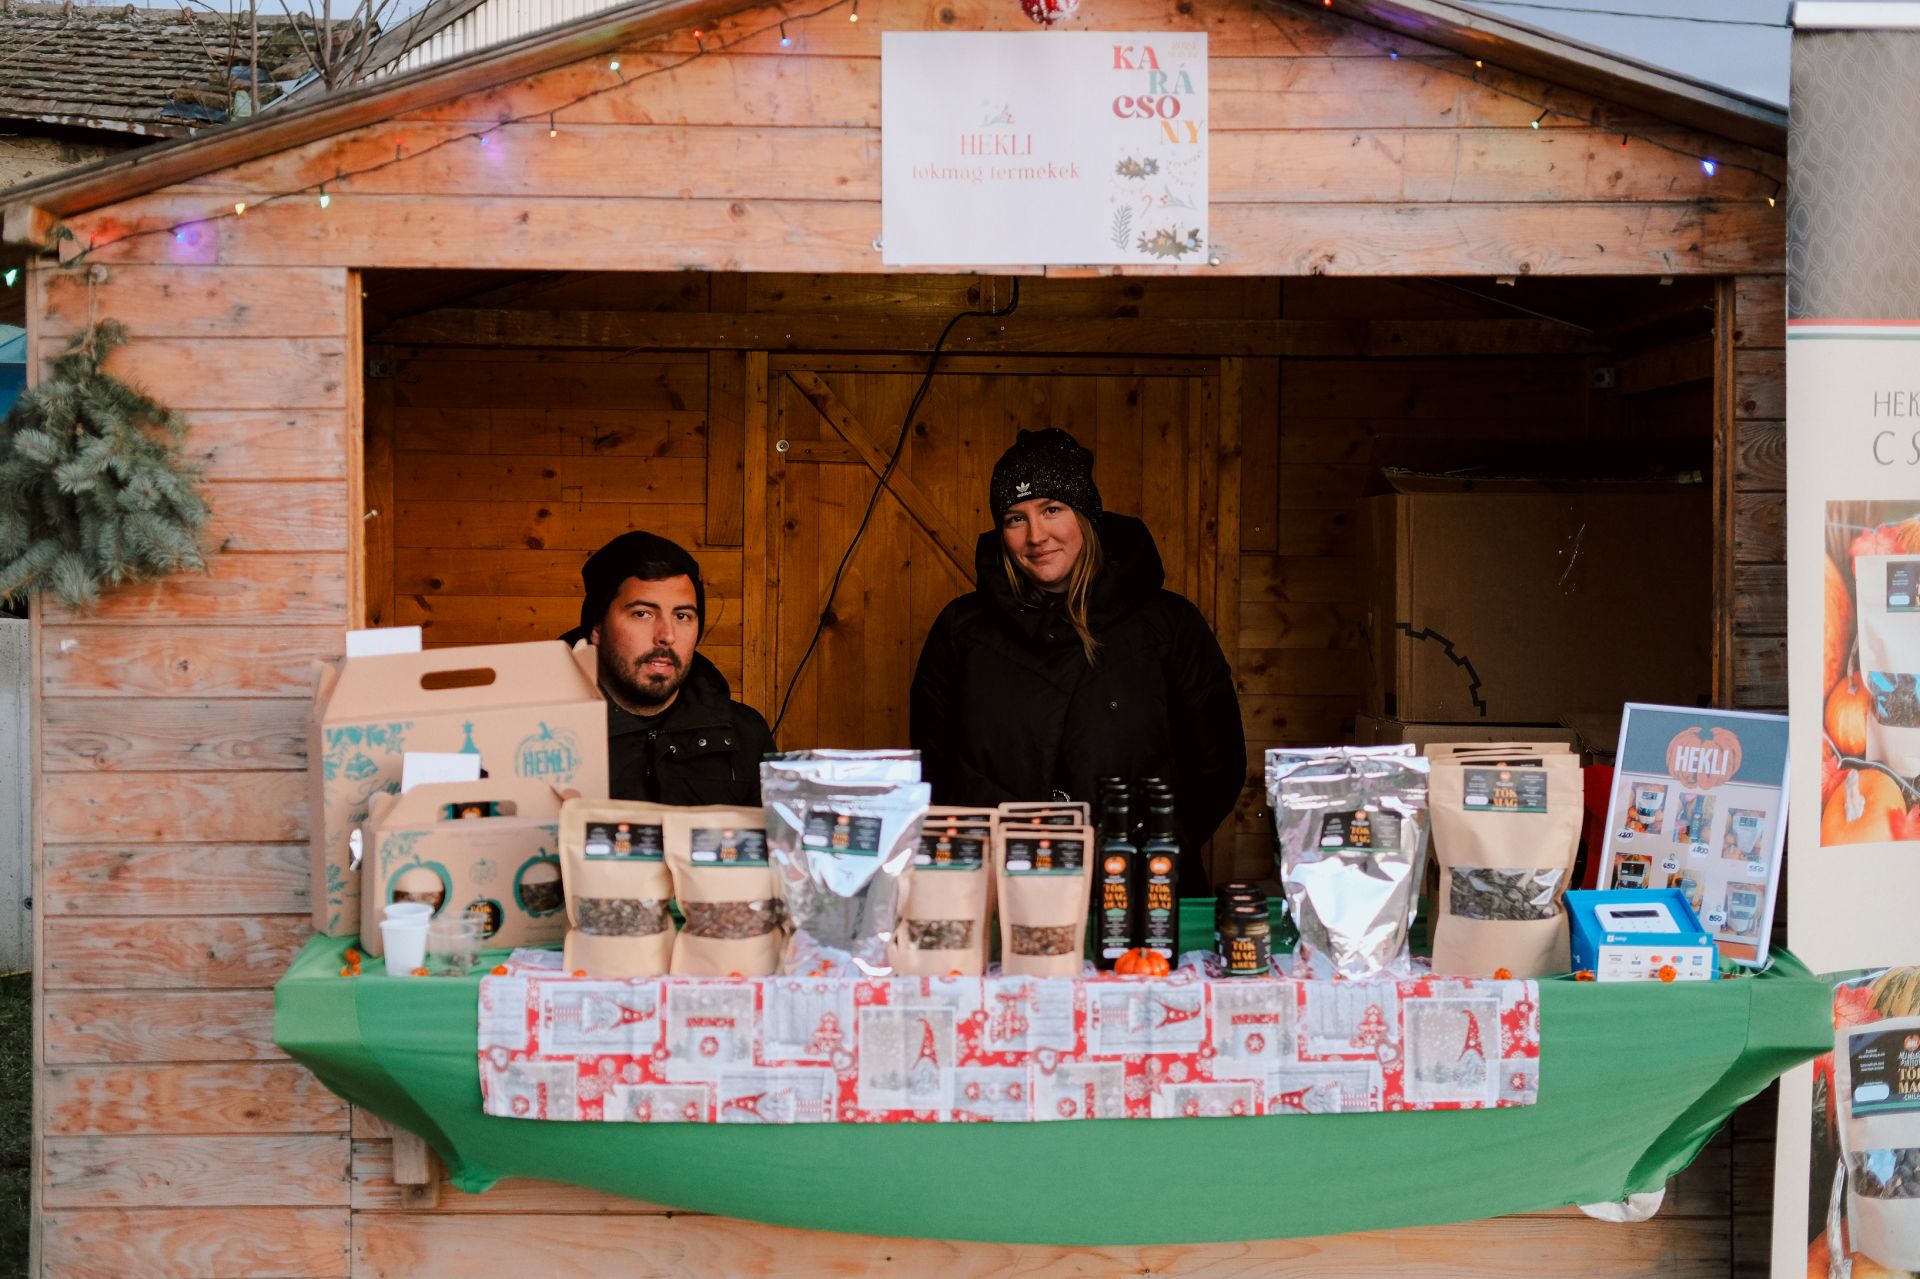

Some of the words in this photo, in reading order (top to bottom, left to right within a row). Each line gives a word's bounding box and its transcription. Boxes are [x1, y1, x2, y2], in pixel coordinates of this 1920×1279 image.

[1112, 45, 1160, 70] KA
[1148, 62, 1194, 94] RÁ
[960, 133, 1032, 155] HEKLI
[1160, 119, 1203, 145] NY
[1674, 745, 1729, 776] HEKLI
